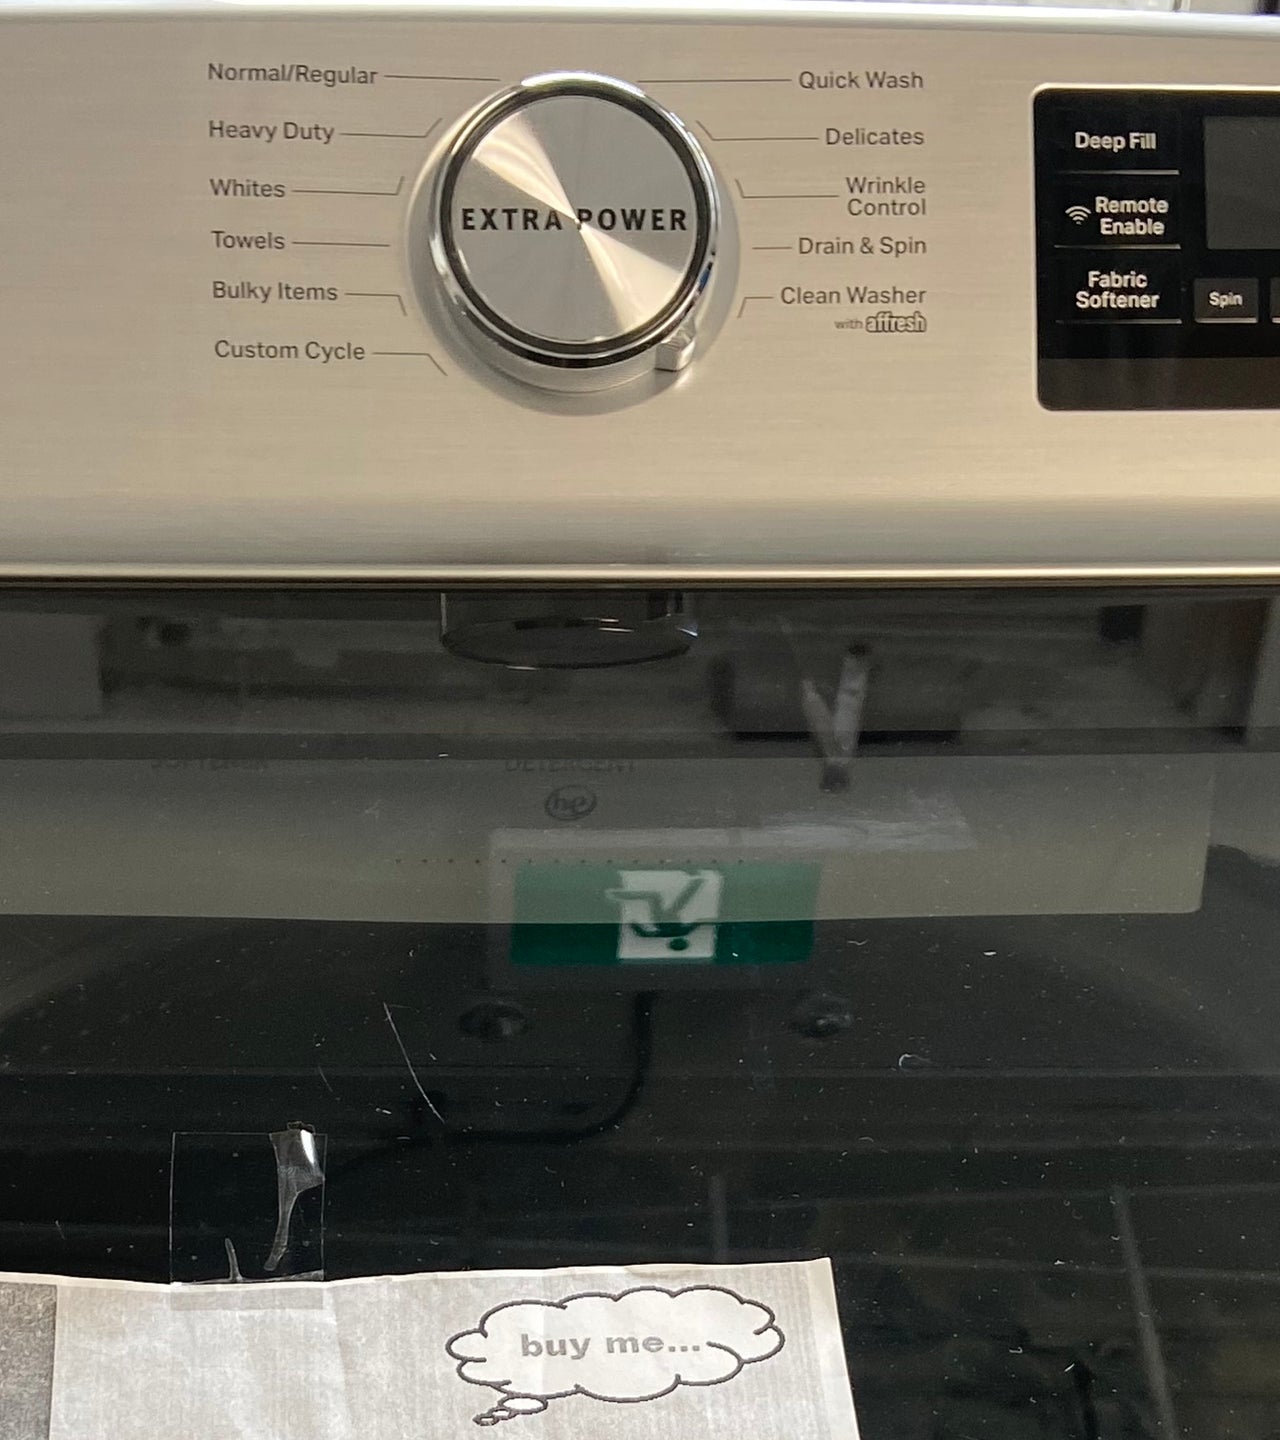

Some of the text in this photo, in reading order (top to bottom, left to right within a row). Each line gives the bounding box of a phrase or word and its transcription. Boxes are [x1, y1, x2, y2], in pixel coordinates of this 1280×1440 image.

[208, 62, 379, 86] Normal/Regular
[798, 70, 925, 91] Quick Wash
[208, 120, 336, 145] Heavy Duty
[824, 127, 926, 147] Delicates
[1074, 131, 1158, 153] Deep Fill
[209, 178, 286, 198] Whites
[845, 176, 927, 195] Wrinkle
[846, 198, 927, 218] Control
[1094, 195, 1170, 215] Remote
[461, 208, 688, 232] EXTRA POWER
[1099, 217, 1166, 236] Enable
[210, 230, 286, 251] Towels
[798, 235, 928, 258] Drain & Spin
[1087, 269, 1149, 290] Fabric
[211, 279, 339, 304] Bulky Items
[780, 286, 928, 306] Clean Washer
[1074, 290, 1161, 310] Softener
[1208, 290, 1244, 308] Spin
[865, 310, 928, 333] affresh
[213, 339, 366, 363] Custom Cycle
[519, 1332, 703, 1361] buy me...
